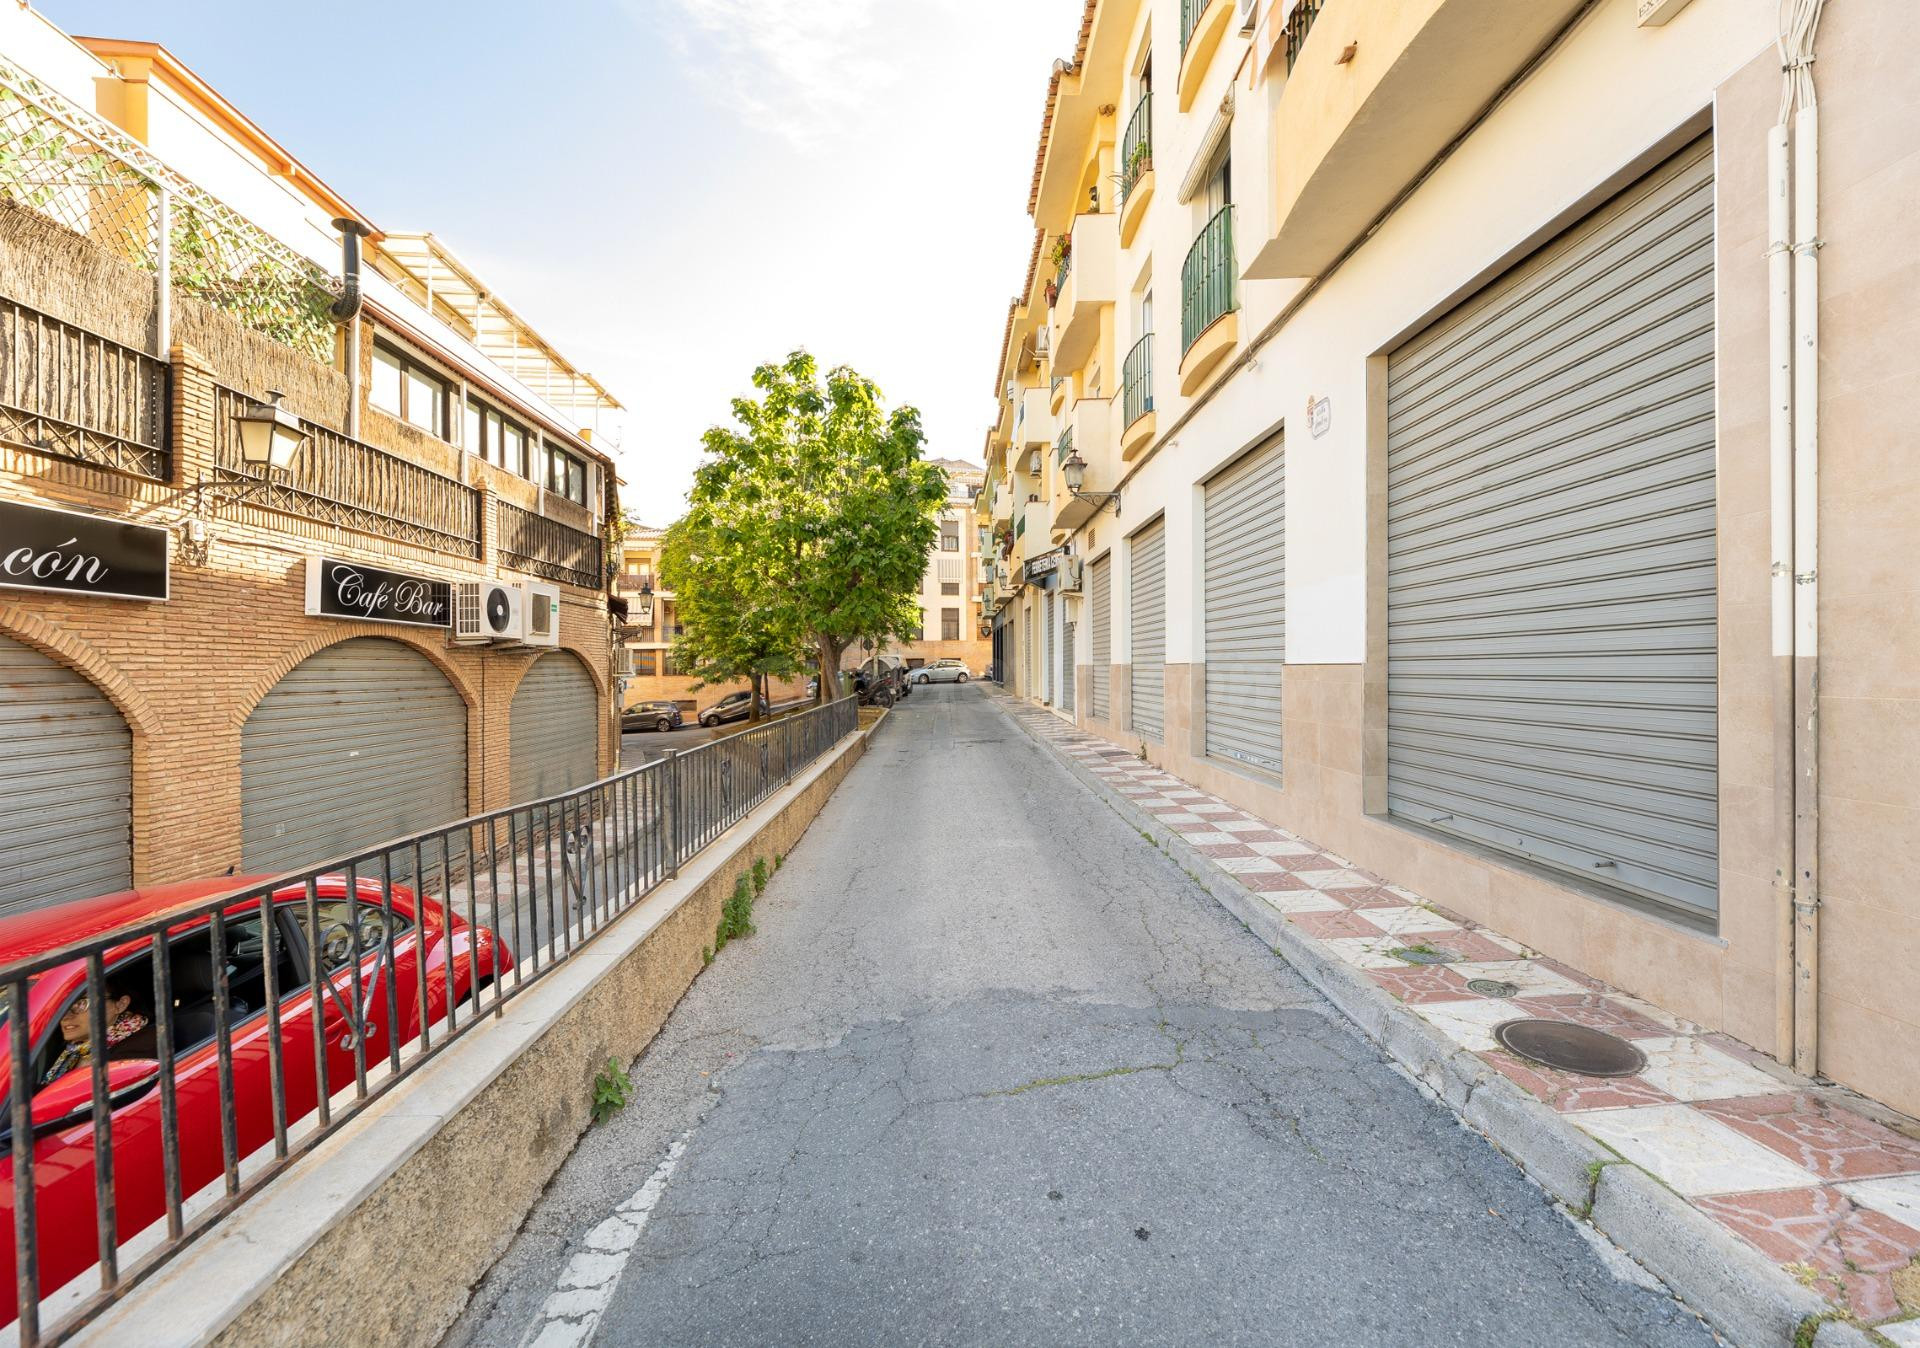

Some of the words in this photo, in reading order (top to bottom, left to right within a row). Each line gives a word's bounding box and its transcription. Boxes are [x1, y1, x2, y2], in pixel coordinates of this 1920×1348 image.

[0, 537, 109, 585] cón
[331, 565, 393, 617] Café
[394, 580, 443, 616] Bar
